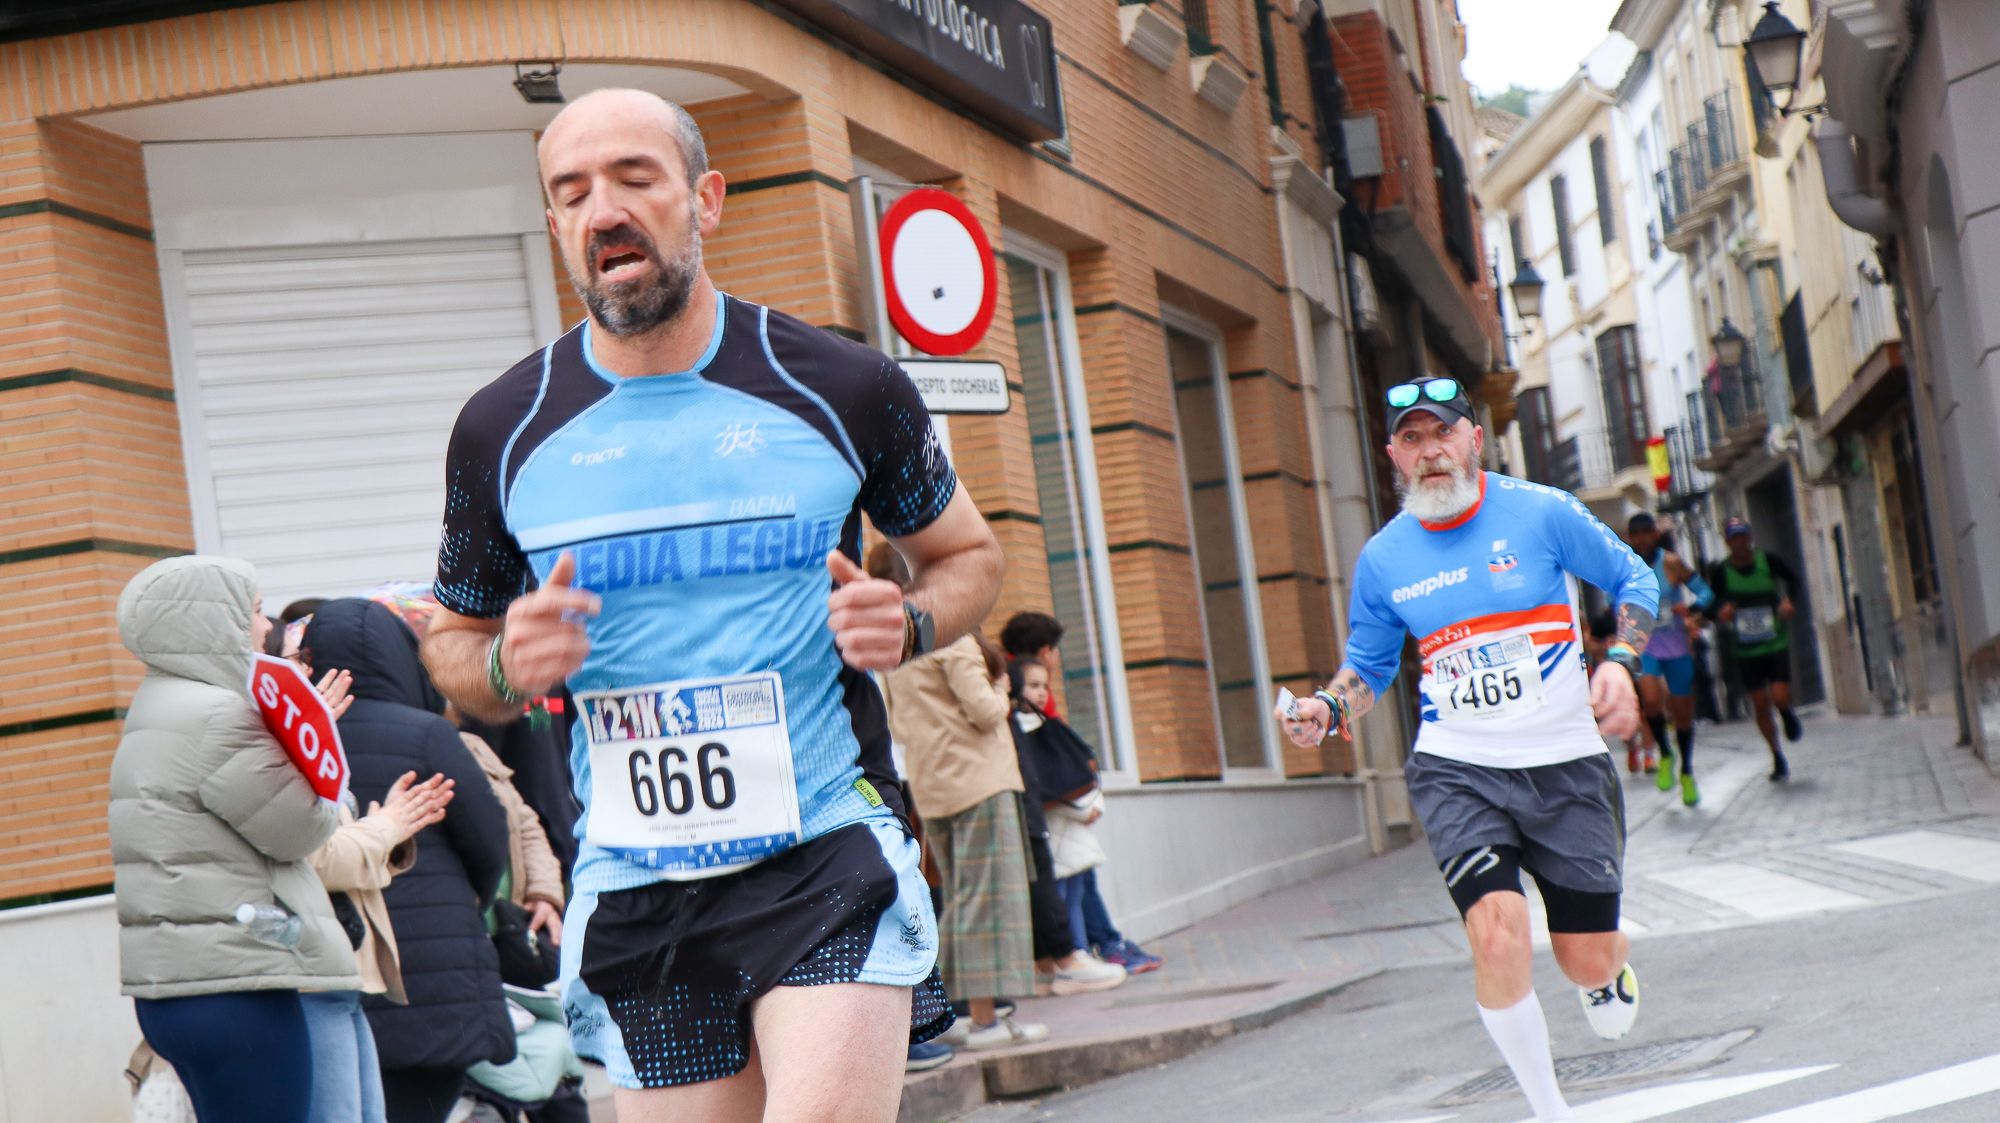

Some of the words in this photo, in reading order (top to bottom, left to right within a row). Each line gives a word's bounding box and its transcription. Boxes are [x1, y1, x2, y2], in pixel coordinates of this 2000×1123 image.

[889, 0, 1006, 71] OLOGICA
[912, 376, 946, 394] CEPTO
[950, 376, 1000, 394] COCHERAS
[584, 445, 627, 467] TACTIC
[729, 493, 797, 519] BAENA
[699, 519, 830, 578] LEGUA
[1391, 566, 1470, 605] enerplus
[258, 672, 339, 781] STOP
[628, 742, 737, 817] 666
